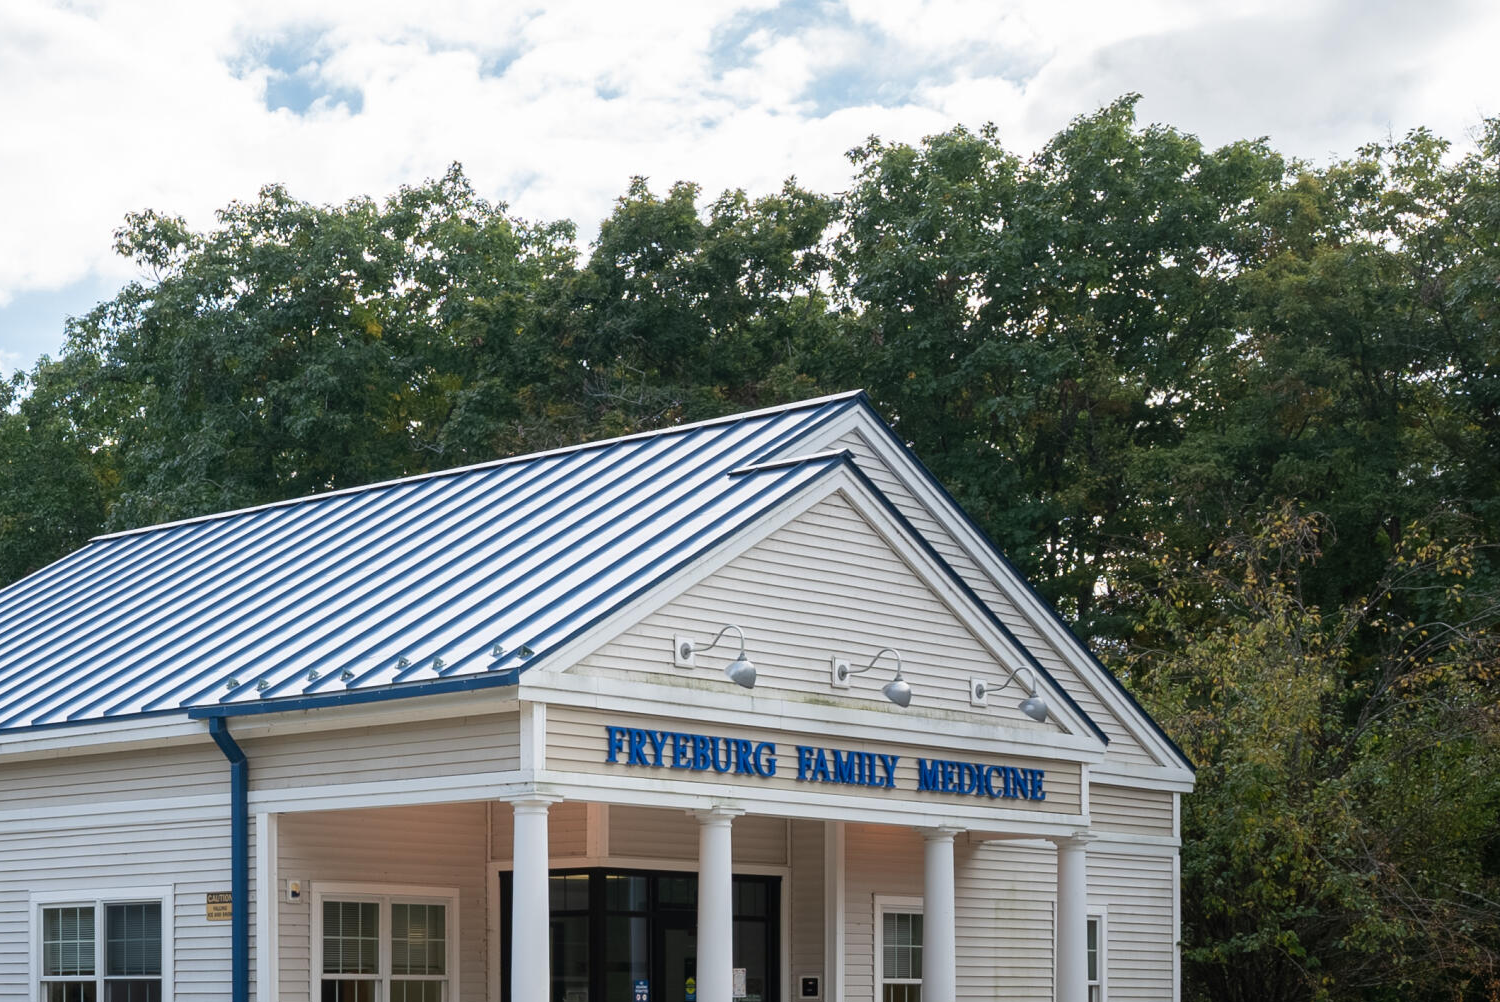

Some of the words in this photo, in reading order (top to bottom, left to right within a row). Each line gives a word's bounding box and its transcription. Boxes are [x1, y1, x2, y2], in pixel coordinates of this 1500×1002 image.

[605, 725, 777, 777] FRYEBURG
[796, 745, 900, 788] FAMILY
[917, 758, 1046, 800] MEDICINE
[208, 894, 232, 903] CAUTION
